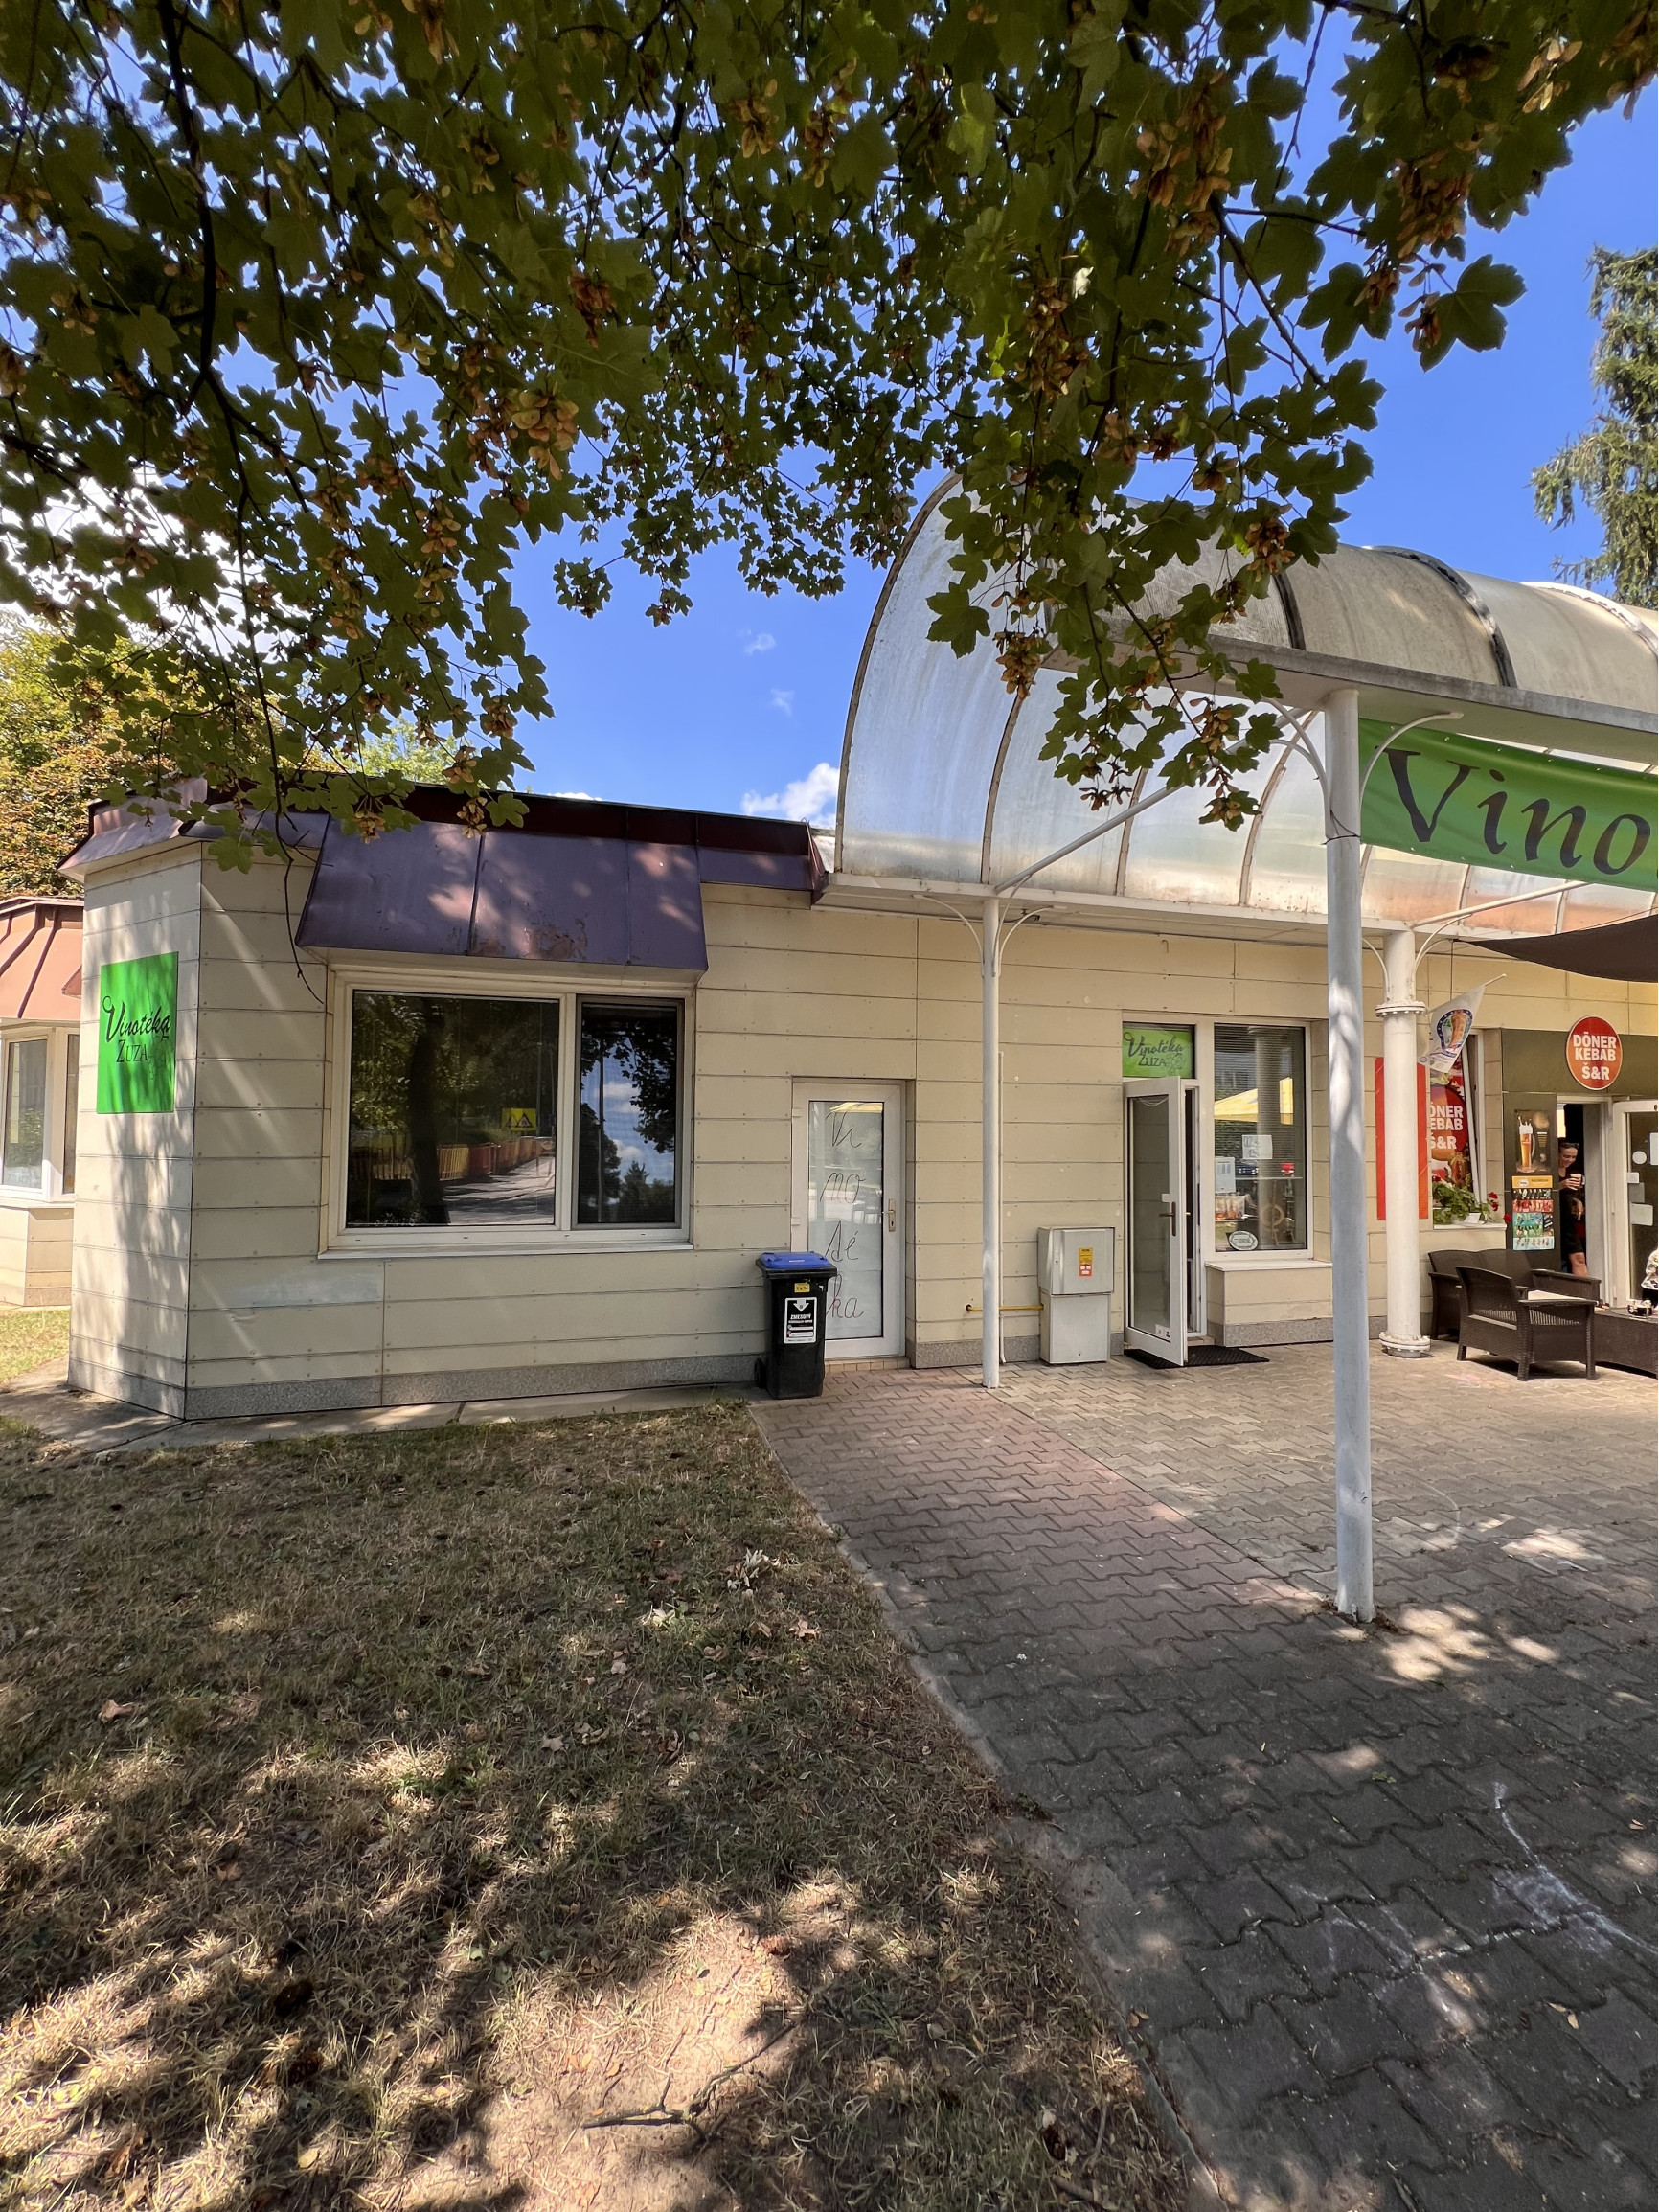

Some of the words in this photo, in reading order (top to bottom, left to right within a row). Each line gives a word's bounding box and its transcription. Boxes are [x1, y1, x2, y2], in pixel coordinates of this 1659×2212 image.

[1375, 744, 1658, 876] Vino
[102, 995, 171, 1042] Vinotéka
[1124, 1032, 1184, 1057] Vinotéka
[1573, 1031, 1617, 1049] DÖNER
[116, 1039, 148, 1063] ZUZA
[1575, 1047, 1617, 1062] KEBAB
[1138, 1055, 1167, 1067] ZUZA
[1581, 1062, 1610, 1081] Š&R
[1430, 1102, 1464, 1118] ÖNER
[1430, 1117, 1464, 1131] EBAB
